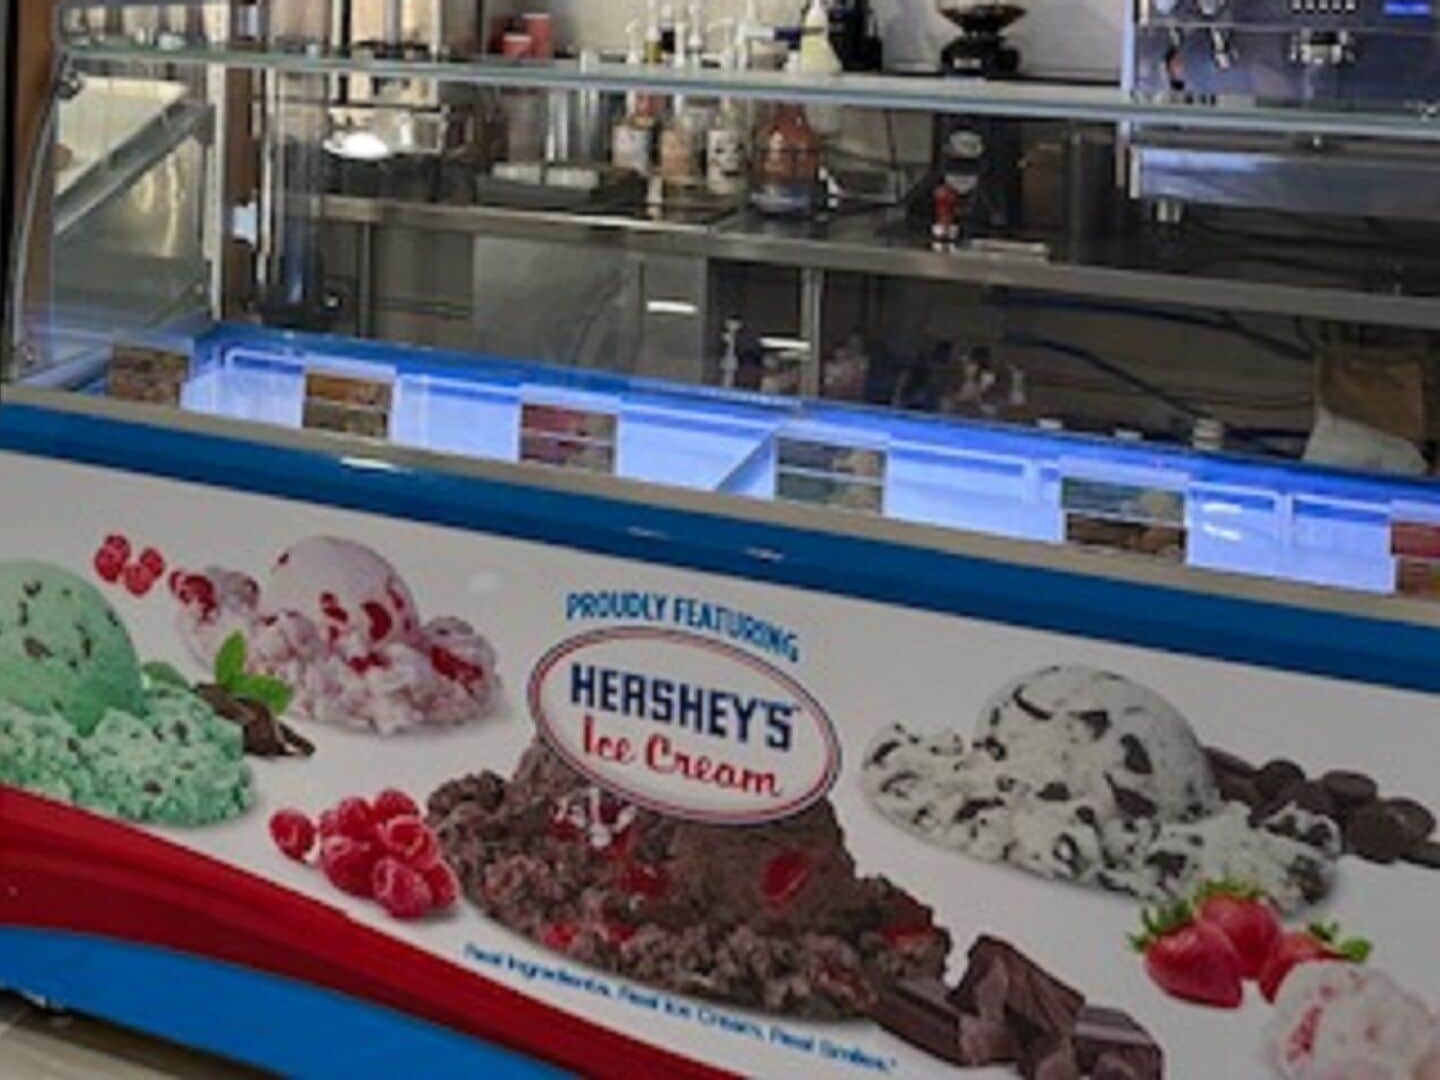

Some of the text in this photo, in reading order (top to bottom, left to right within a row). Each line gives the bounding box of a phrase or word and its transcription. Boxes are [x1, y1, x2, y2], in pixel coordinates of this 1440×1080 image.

[566, 590, 799, 663] PROUDLY FEATURING
[570, 661, 795, 752] HERSHEY'S
[582, 714, 784, 797] Ice Cream
[464, 941, 503, 967] Real
[616, 984, 659, 1011] Real
[663, 997, 691, 1019] Ice
[768, 1024, 815, 1054] Real
